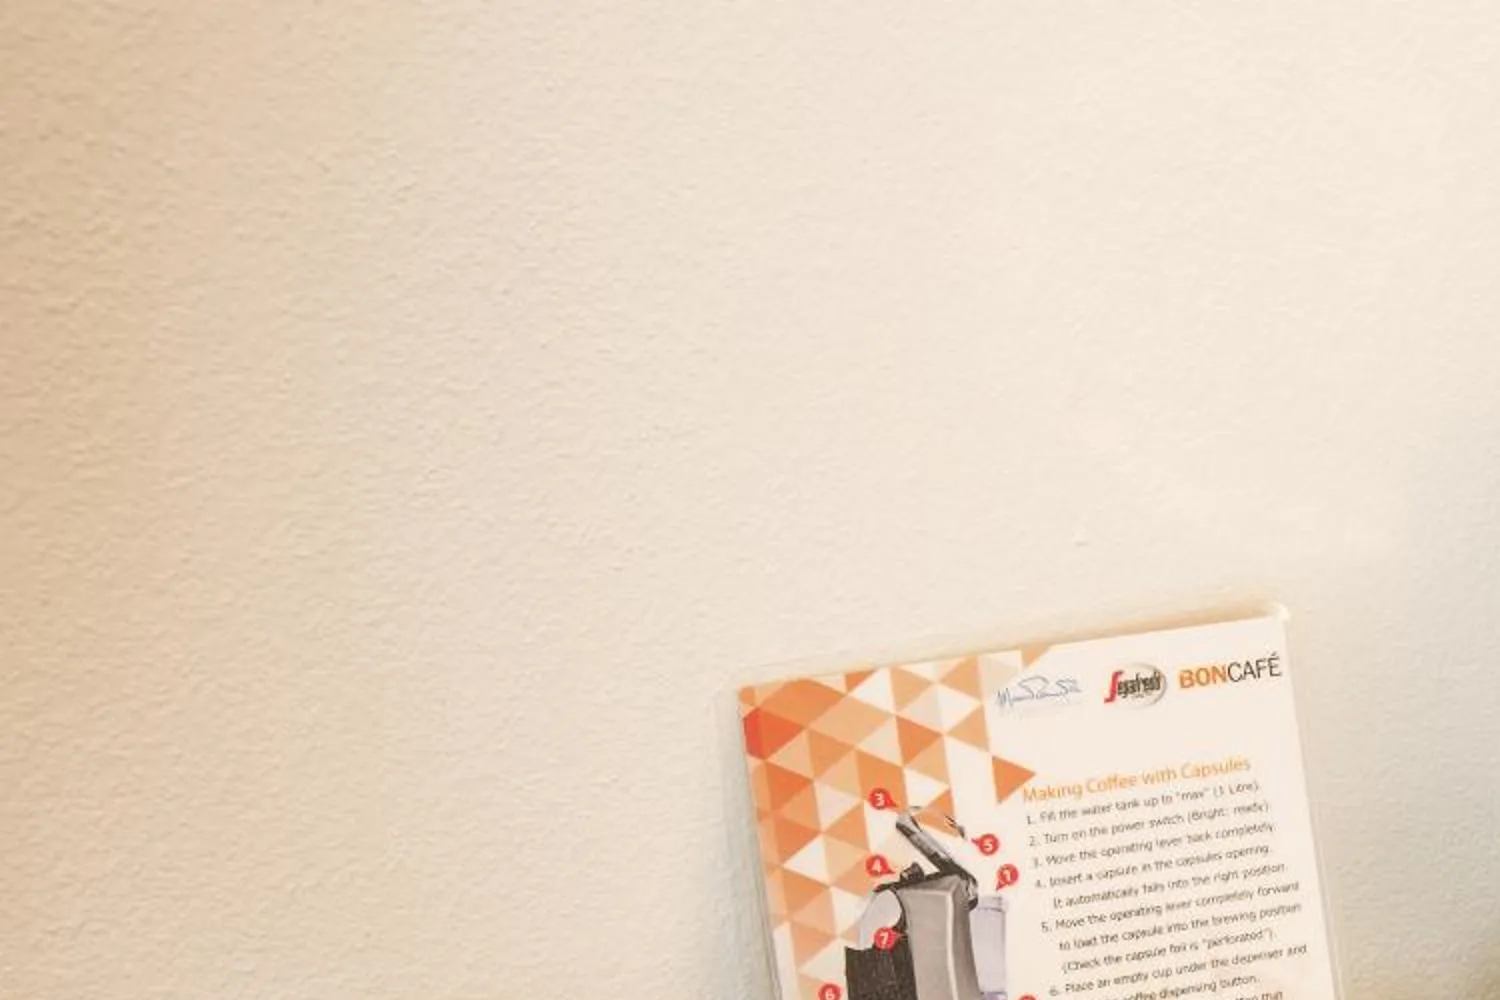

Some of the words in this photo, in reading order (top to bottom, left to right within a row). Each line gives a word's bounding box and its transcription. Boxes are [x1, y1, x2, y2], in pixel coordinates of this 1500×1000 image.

[1180, 653, 1283, 690] BONCAFÉ
[1023, 782, 1082, 803] Making
[1086, 774, 1137, 793] Coffee
[1141, 766, 1177, 785] with
[1180, 757, 1250, 782] Capsules
